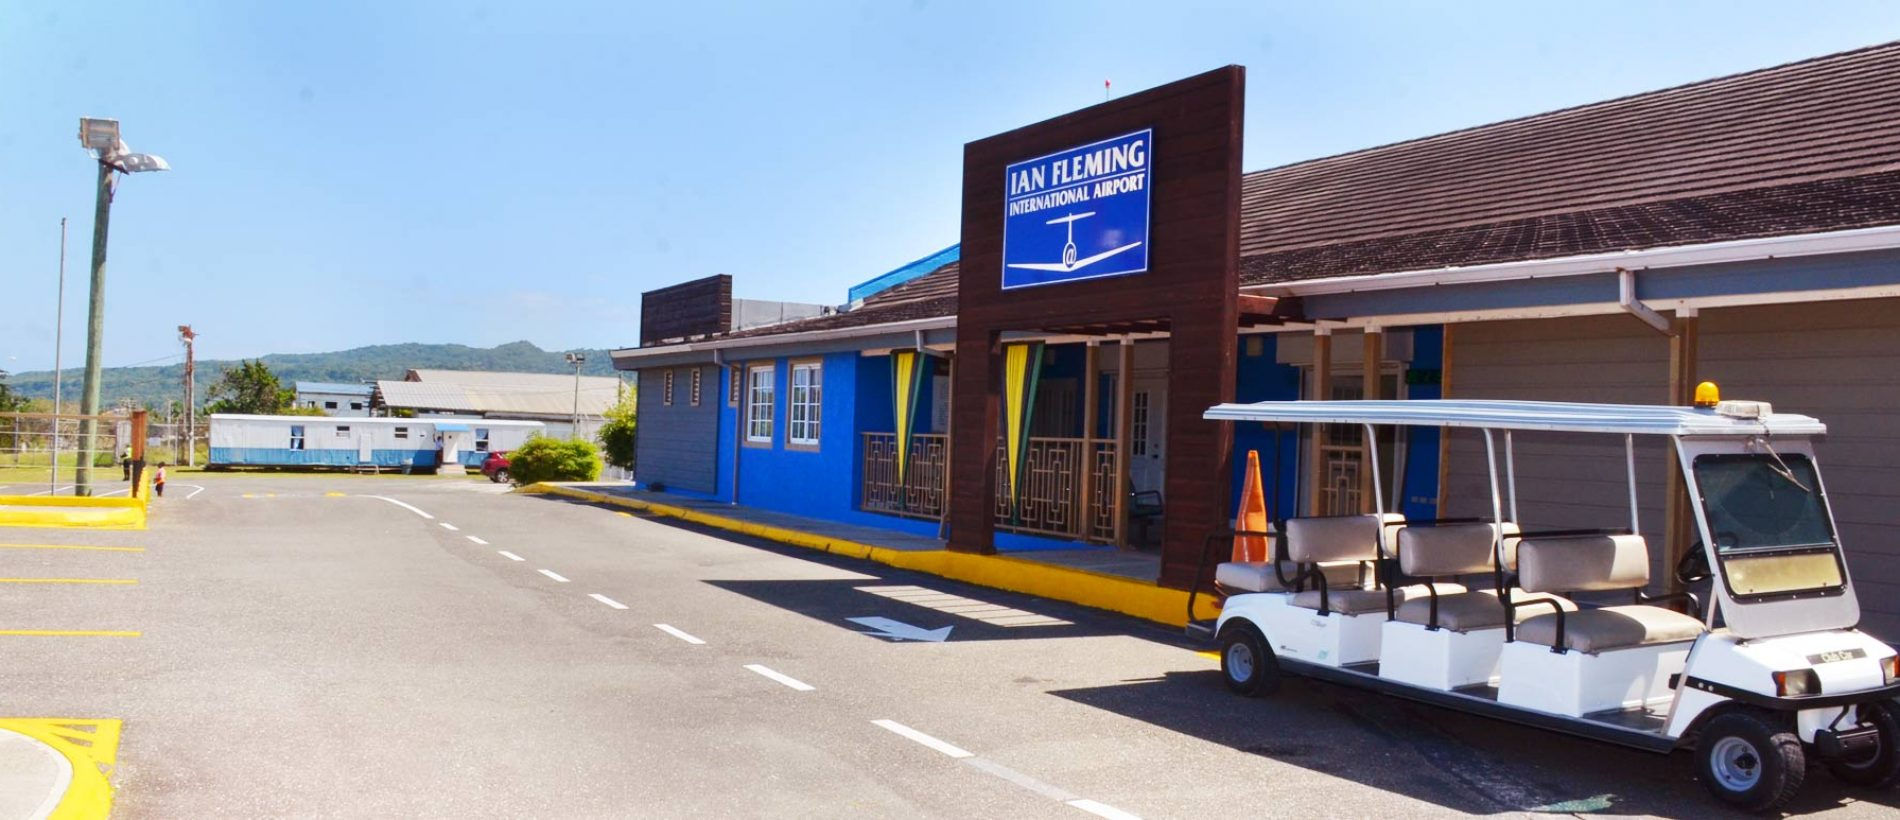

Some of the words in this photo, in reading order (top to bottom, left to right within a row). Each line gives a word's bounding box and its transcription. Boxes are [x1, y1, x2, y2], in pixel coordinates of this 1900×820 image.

[1011, 165, 1045, 195] IAN
[1052, 140, 1145, 185] FLEMING
[1010, 186, 1090, 216] INTERNATIONAL
[1093, 173, 1145, 199] AIRPORT
